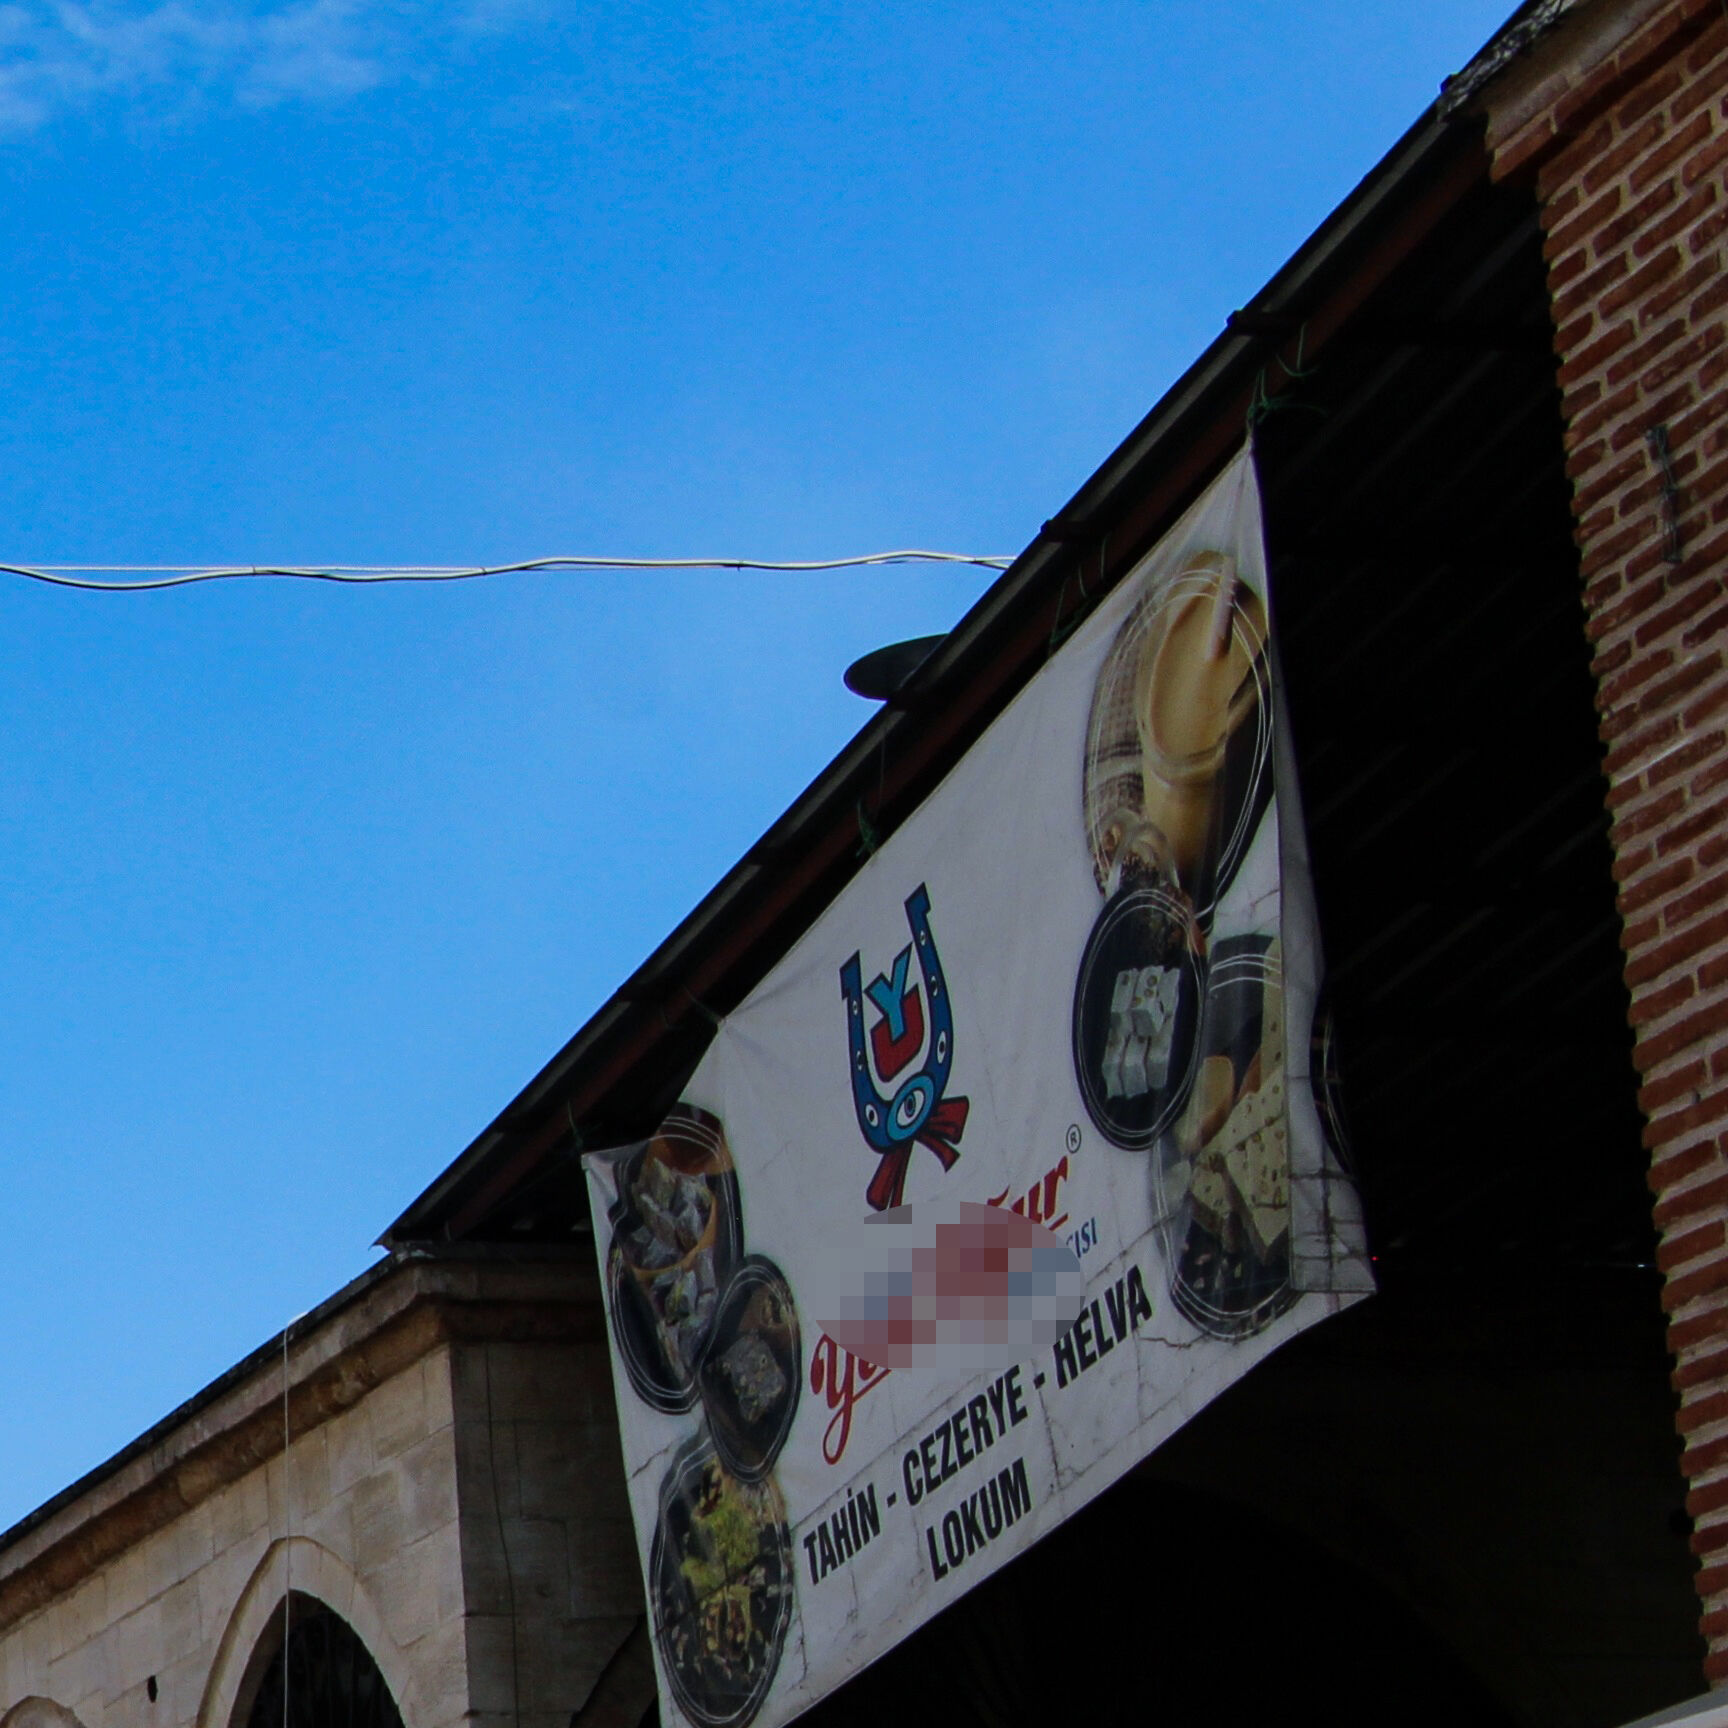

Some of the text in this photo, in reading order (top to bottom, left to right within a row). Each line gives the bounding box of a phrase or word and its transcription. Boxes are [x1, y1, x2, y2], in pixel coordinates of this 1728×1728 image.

[804, 1485, 881, 1584] TAHİN
[903, 1365, 1028, 1506] CEZERYE
[1054, 1265, 1152, 1389] HELVA
[927, 1458, 1032, 1581] LOKUM
